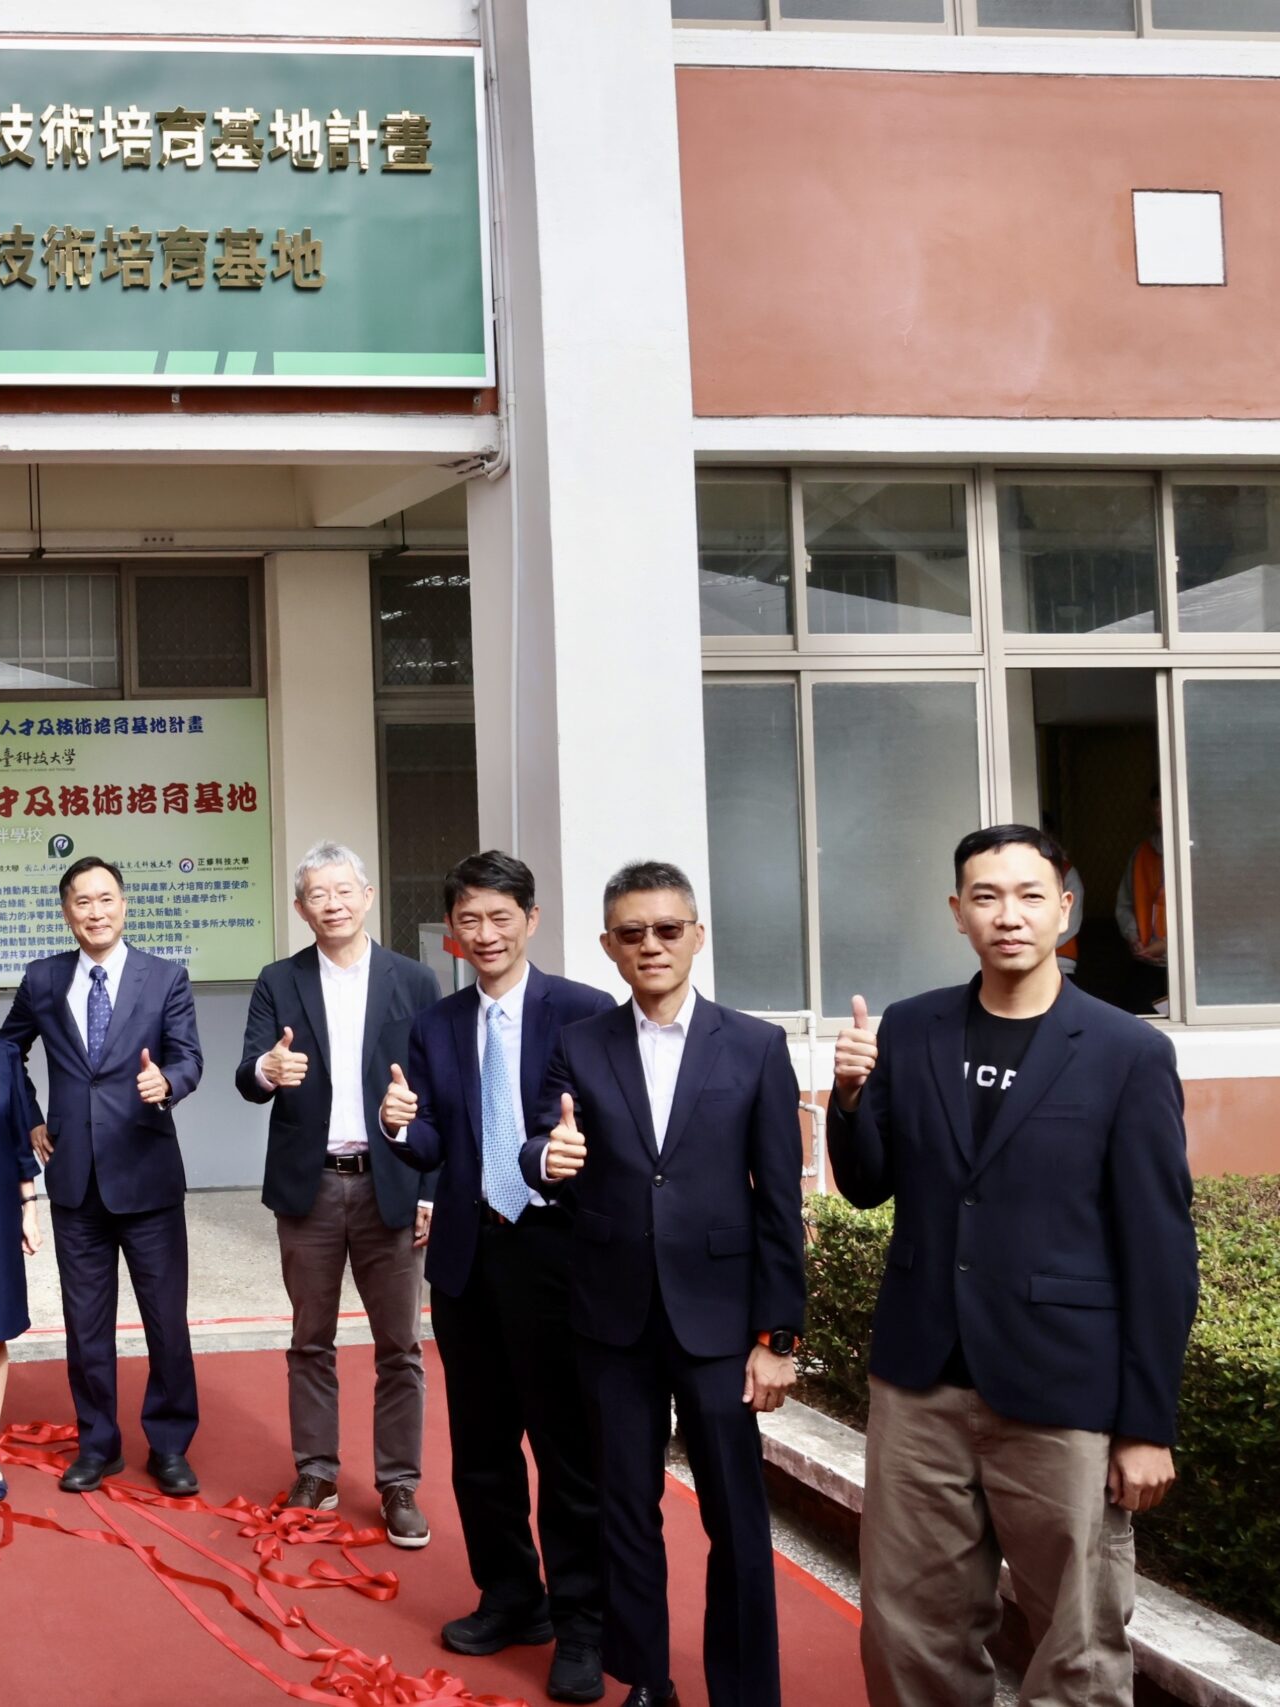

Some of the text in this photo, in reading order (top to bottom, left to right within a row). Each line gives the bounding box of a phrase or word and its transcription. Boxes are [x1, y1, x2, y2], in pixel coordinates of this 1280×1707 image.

[198, 857, 249, 867] 正修科技大學
[124, 907, 189, 918] 型注入新動能。
